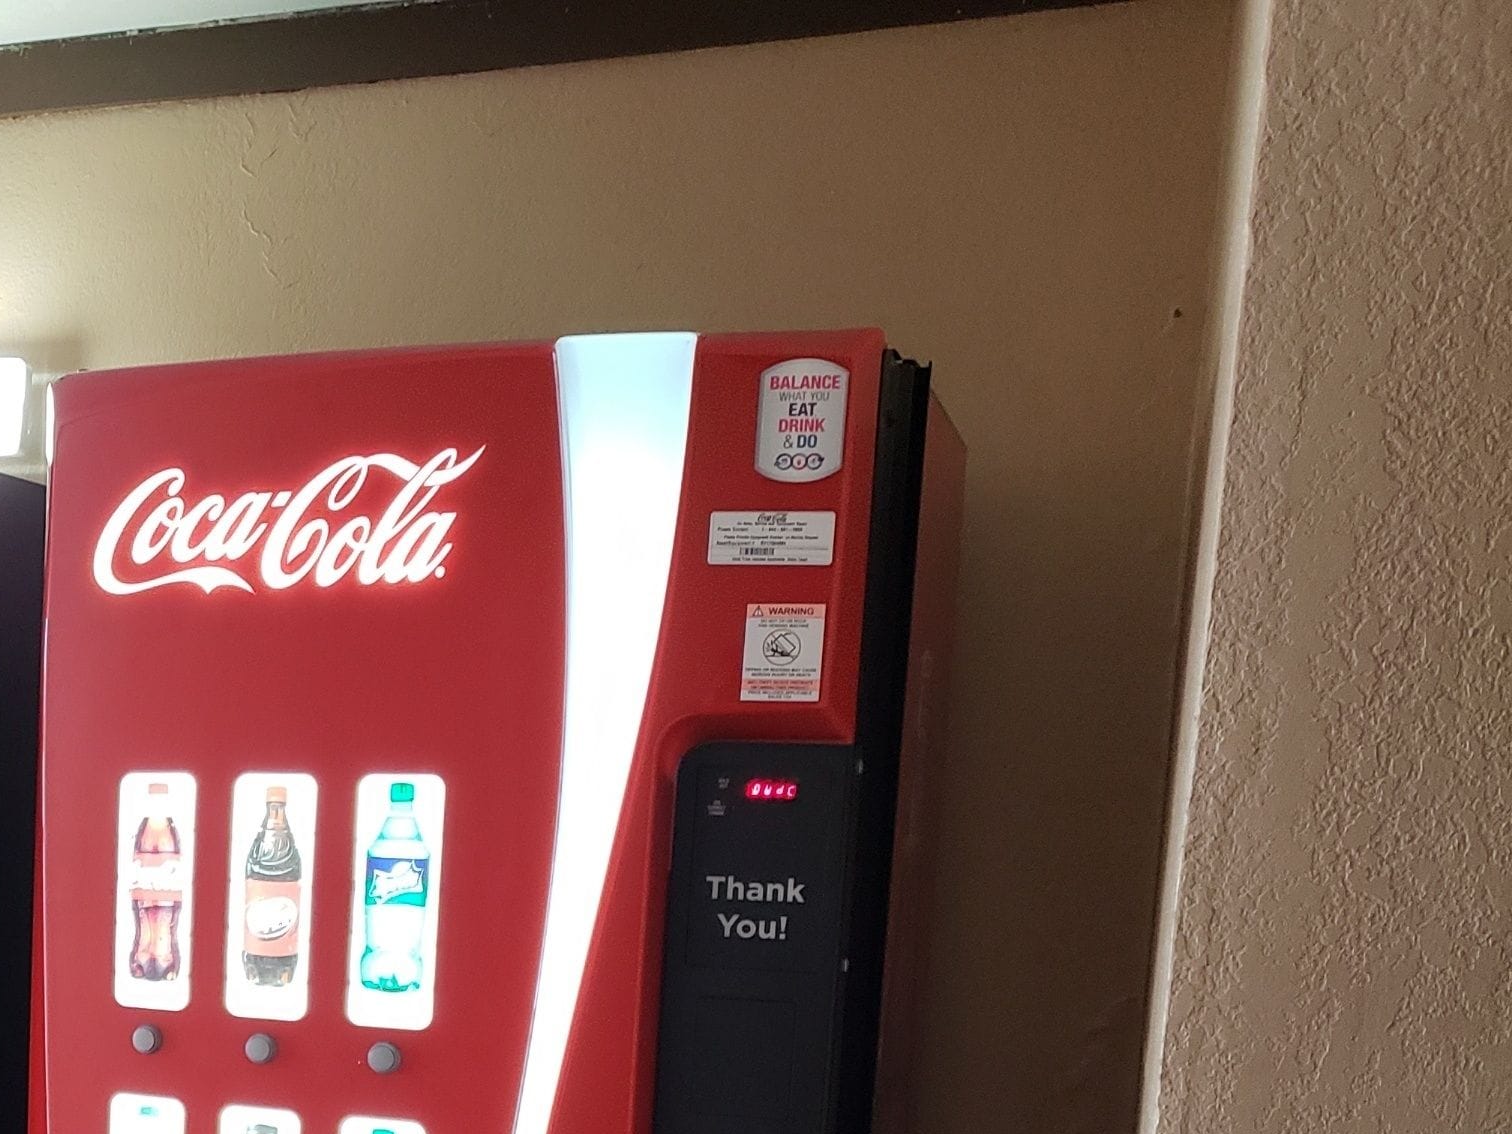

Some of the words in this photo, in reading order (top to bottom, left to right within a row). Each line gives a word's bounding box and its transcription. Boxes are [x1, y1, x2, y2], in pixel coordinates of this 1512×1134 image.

[769, 375, 841, 390] BALANCE
[779, 391, 807, 402] WHAT
[811, 391, 831, 401] YOU
[789, 402, 818, 416] EAT
[778, 418, 826, 433] DRINK
[783, 434, 794, 449] &
[797, 434, 818, 449] DO
[92, 444, 487, 596] Coca-Cola
[768, 607, 815, 616] WARNING
[705, 875, 806, 904] Thank
[717, 913, 788, 941] You!
